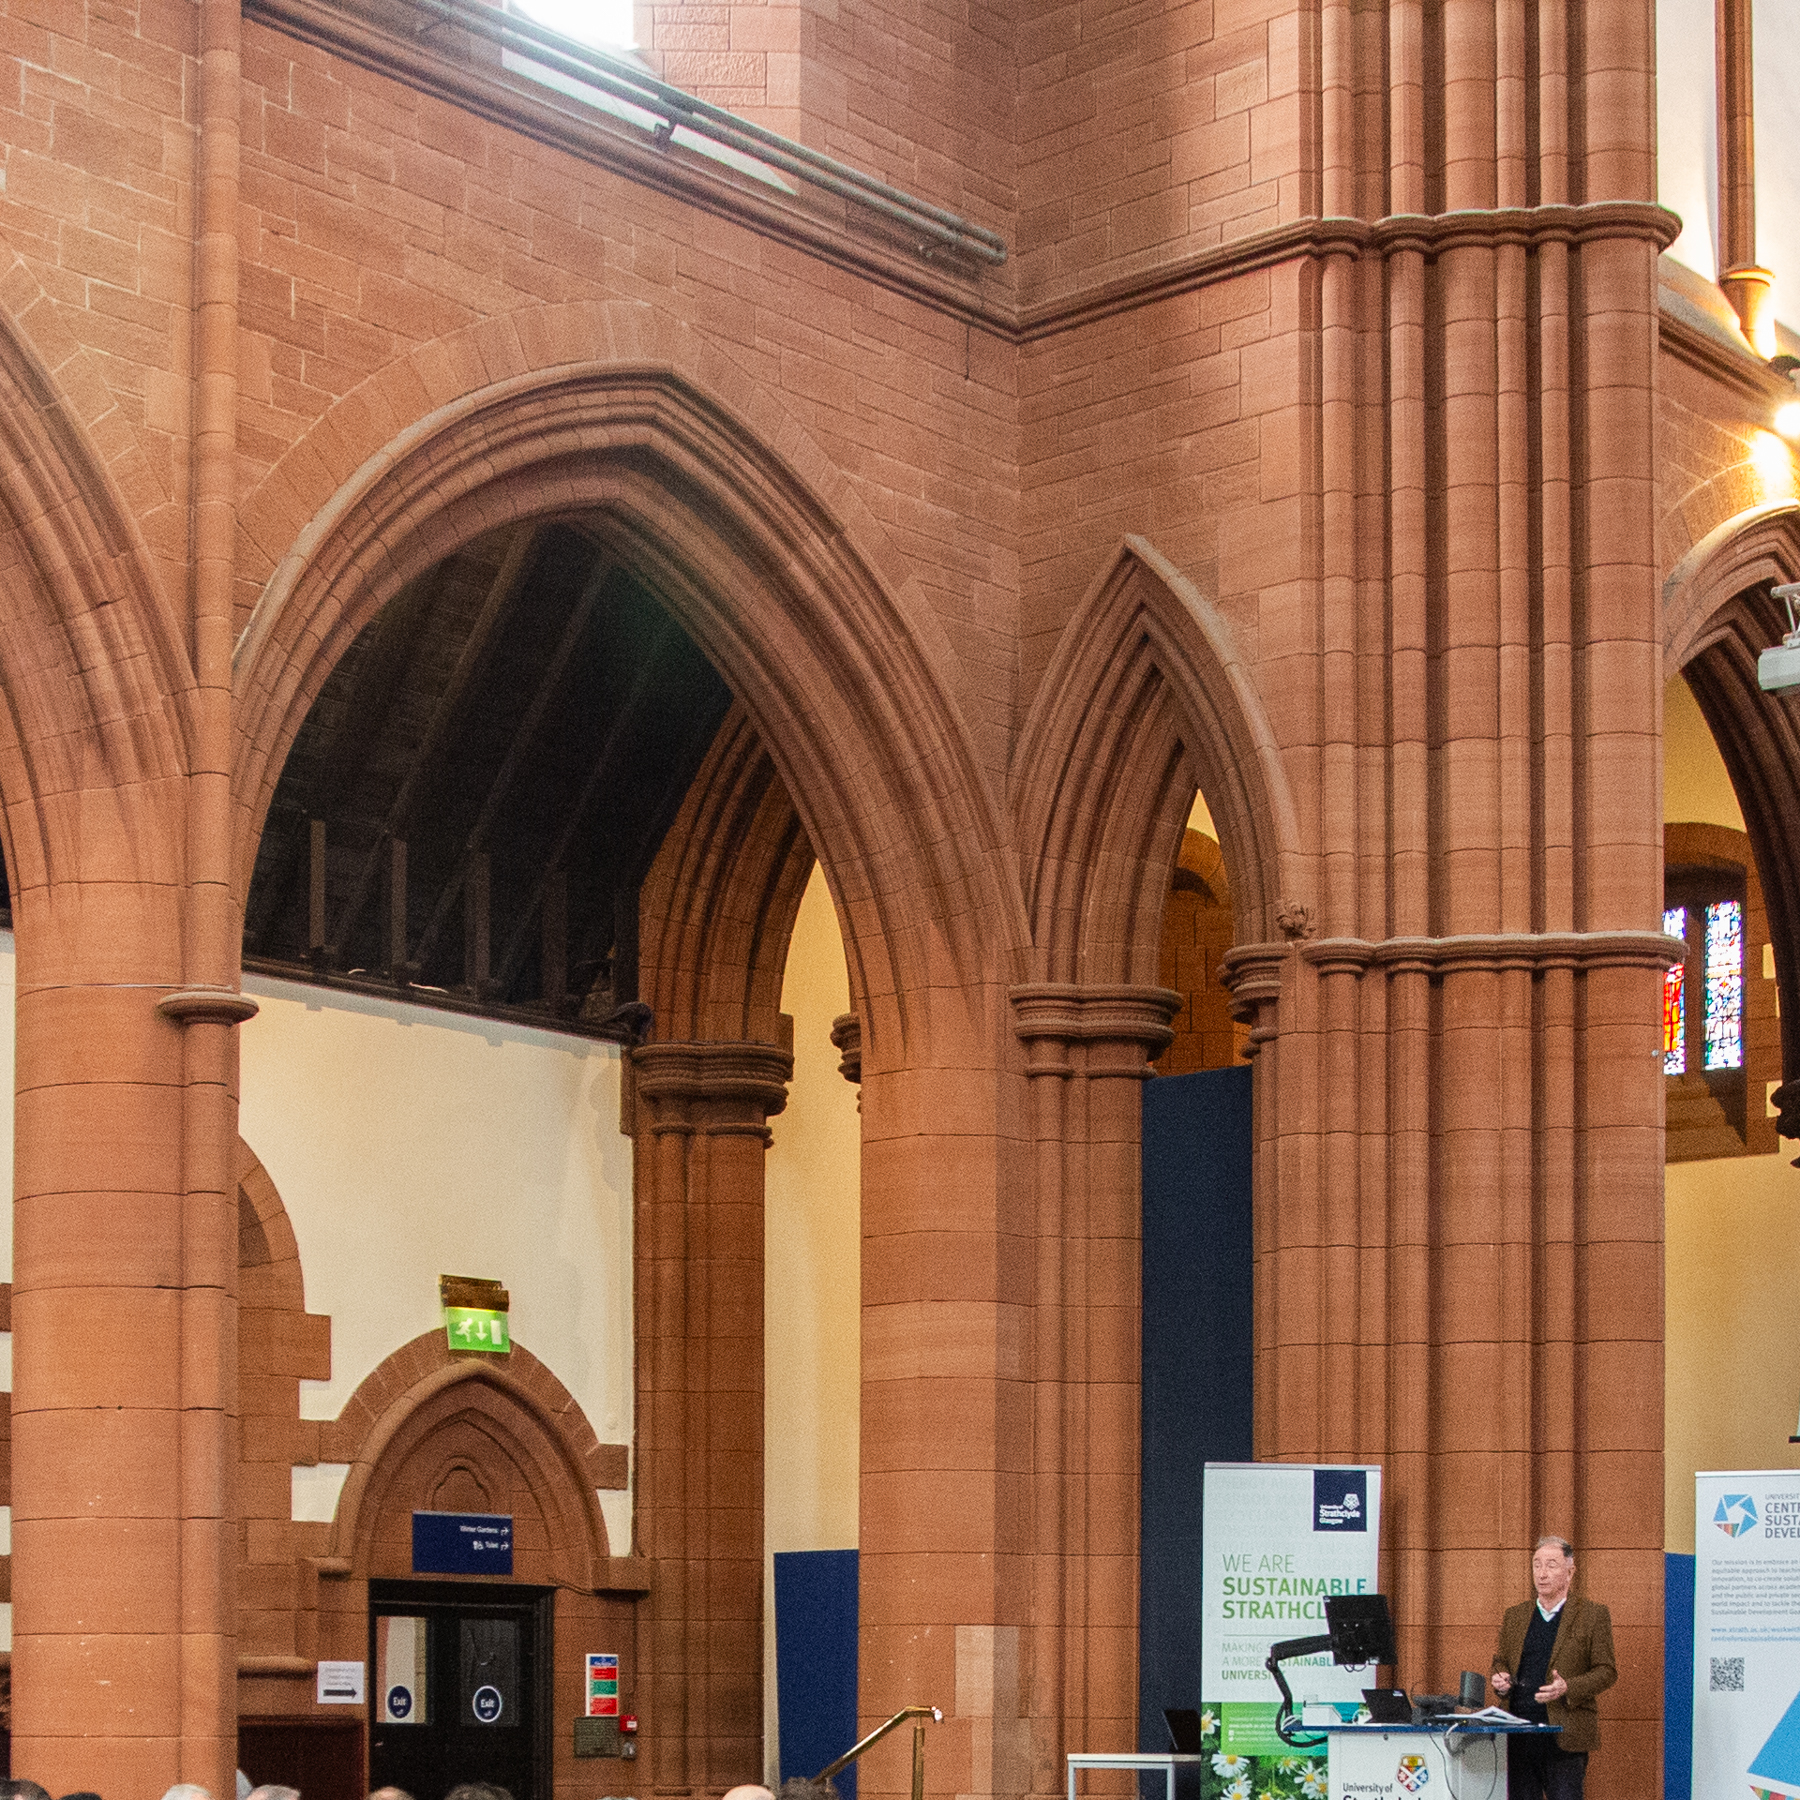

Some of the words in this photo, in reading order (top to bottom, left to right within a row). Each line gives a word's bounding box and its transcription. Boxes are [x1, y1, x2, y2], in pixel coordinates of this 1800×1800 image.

[1319, 1509, 1360, 1519] Strathclyde
[1222, 1553, 1252, 1573] WE
[1258, 1554, 1295, 1574] ARE
[1222, 1577, 1367, 1597] SUSTAINABLE
[1222, 1600, 1328, 1620] STRATHCL
[393, 1697, 406, 1706] Exit
[480, 1699, 494, 1708] Exit
[1343, 1782, 1383, 1794] University
[1384, 1783, 1393, 1793] of
